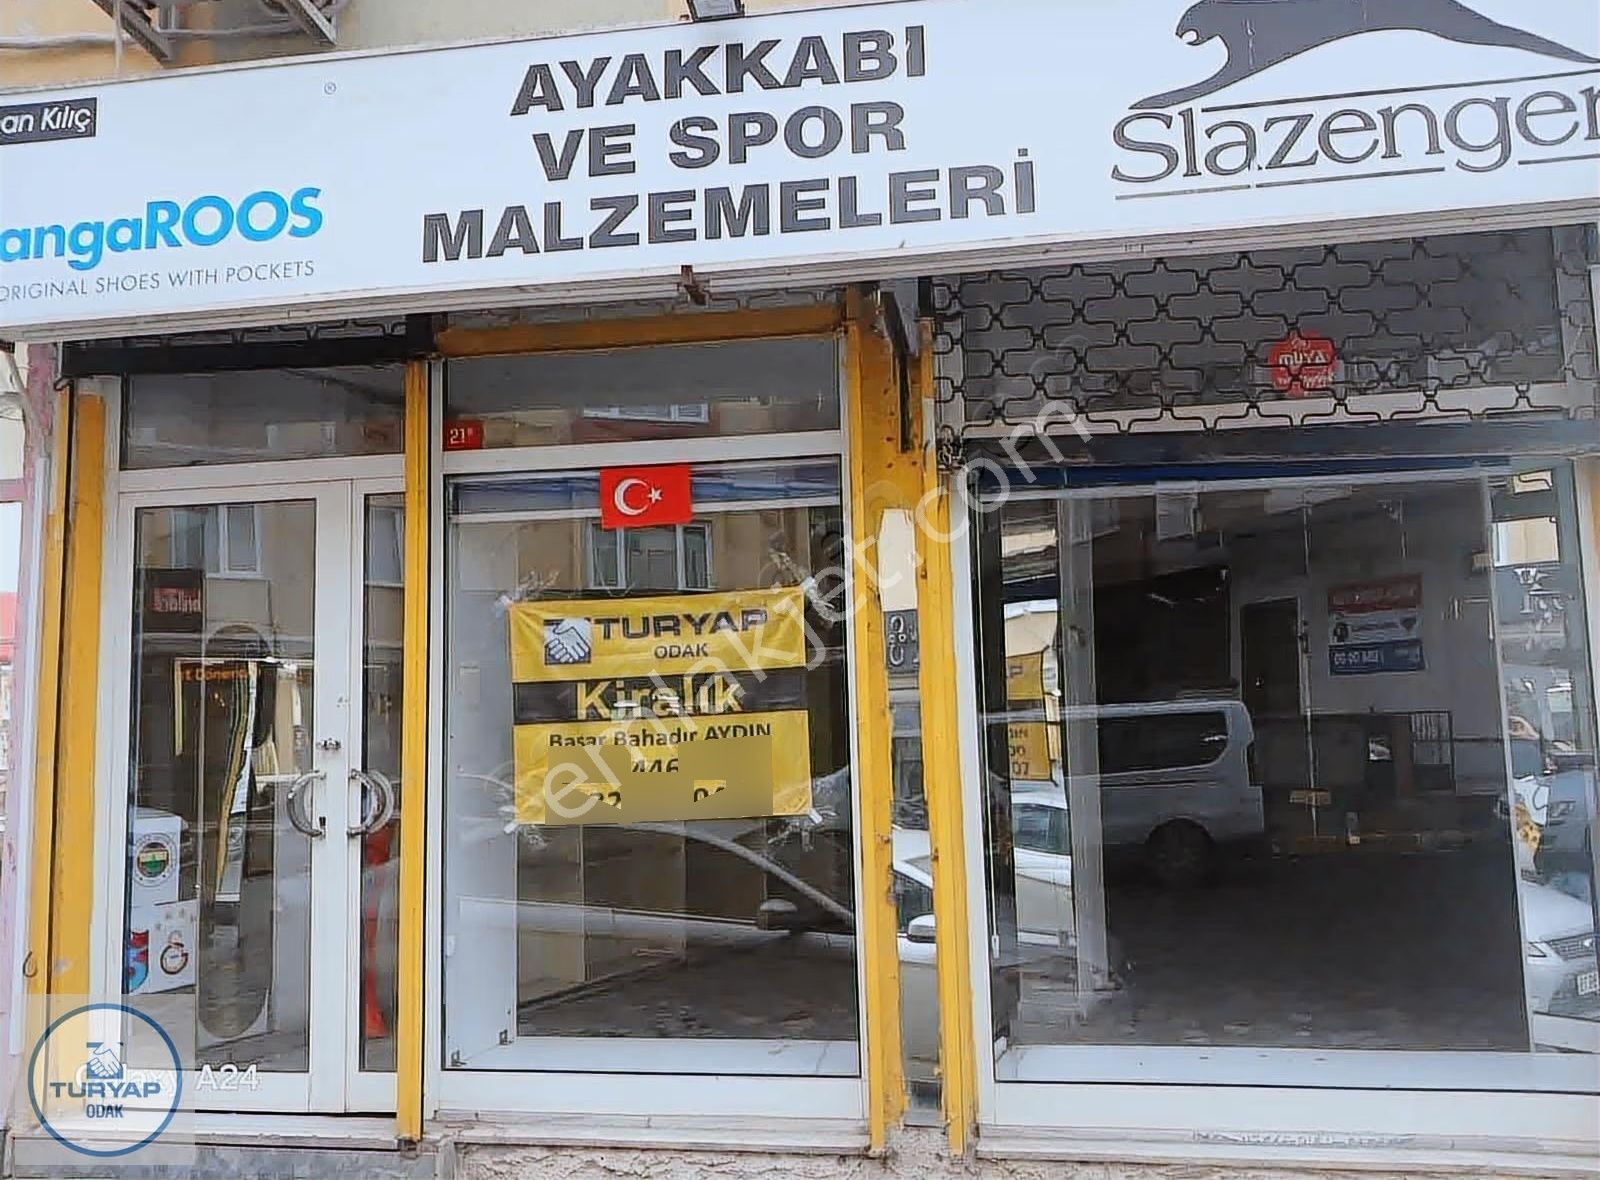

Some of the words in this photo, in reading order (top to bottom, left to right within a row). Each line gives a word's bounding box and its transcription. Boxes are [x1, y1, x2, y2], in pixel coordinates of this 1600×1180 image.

[510, 25, 926, 116] AYAKKABI
[41, 105, 91, 133] Kılıç
[533, 124, 636, 182] VE
[669, 101, 907, 169] SPOR
[422, 148, 1036, 263] MALZEMELERİ
[96, 273, 160, 293] SHOES
[168, 267, 218, 288] WITH
[226, 260, 315, 283] POCKETS
[595, 609, 768, 640] TURYAP
[654, 643, 709, 659] ODAK
[576, 674, 745, 720] Kiralık
